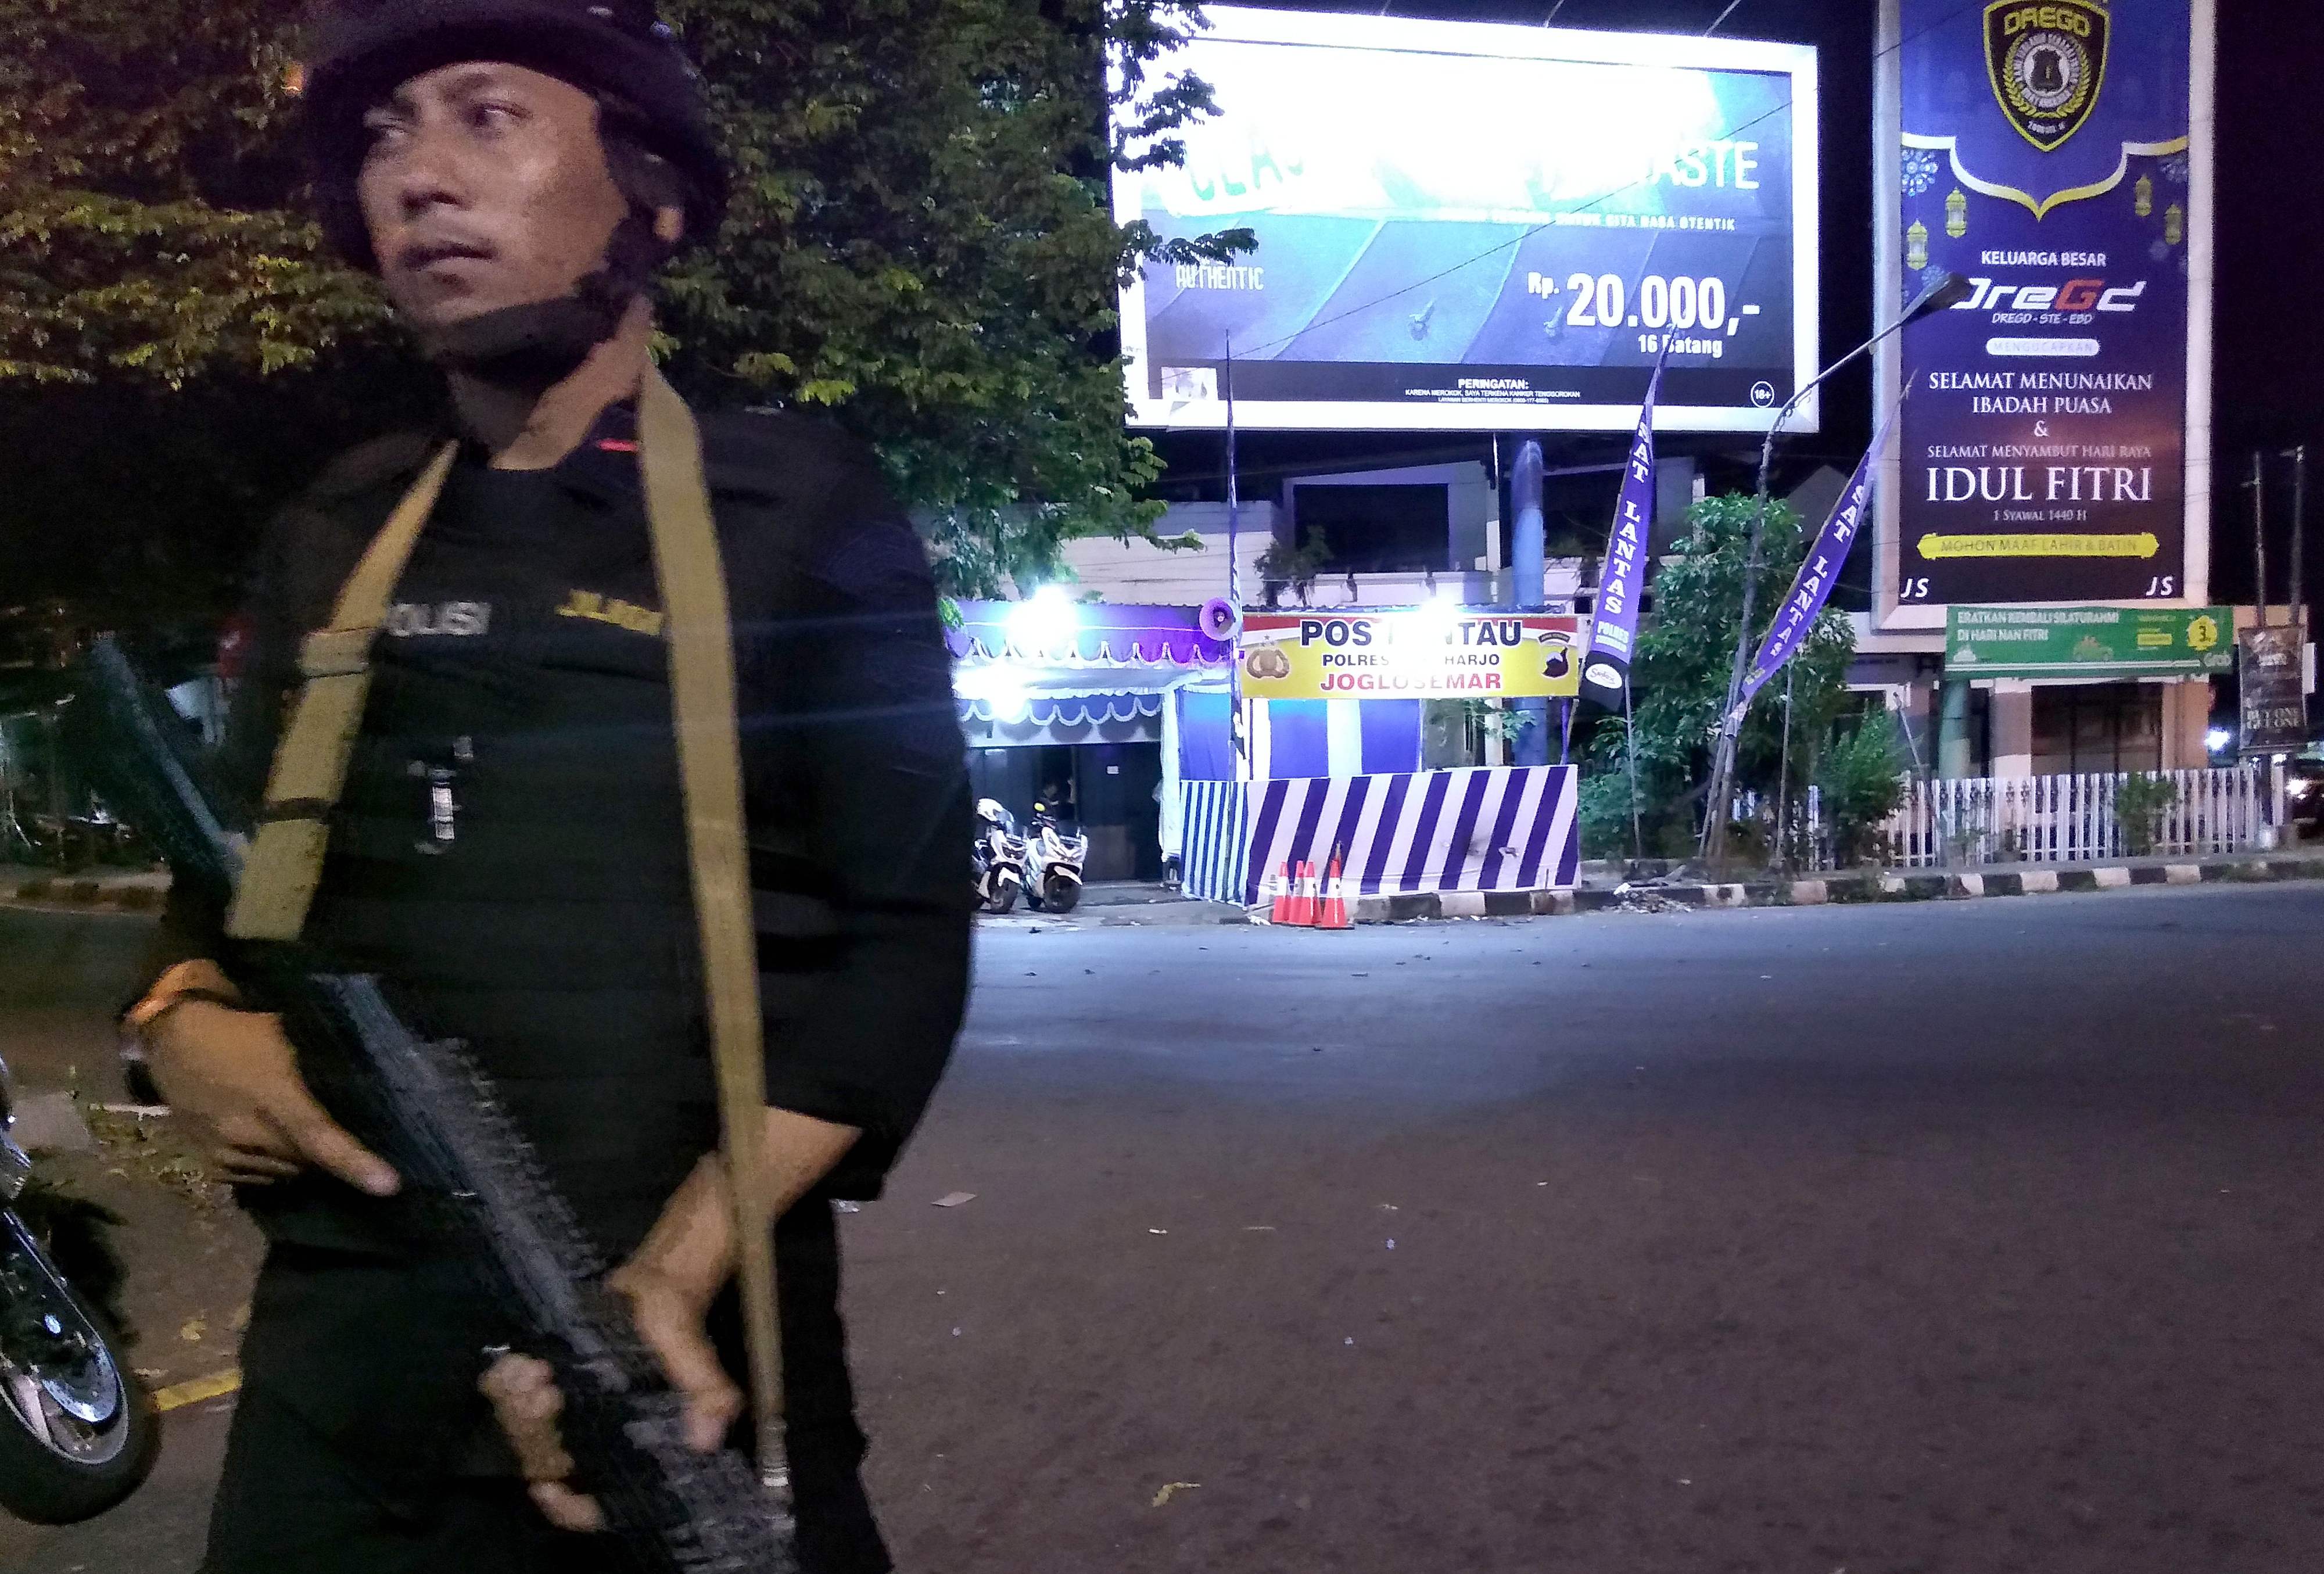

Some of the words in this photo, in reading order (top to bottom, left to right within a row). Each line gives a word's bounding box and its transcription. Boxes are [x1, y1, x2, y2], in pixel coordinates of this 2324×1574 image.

[1641, 215, 1675, 229] RASA
[1680, 216, 1735, 231] OTENTIK
[1982, 250, 2057, 267] KELUARGA
[2061, 252, 2107, 267] BESAR
[1176, 265, 1264, 291] AUTHENTIC
[1528, 272, 1559, 299] Rp.
[1638, 335, 1658, 353] 16
[1458, 378, 1529, 389] PERINGATAN:
[1929, 372, 2015, 390] SELAMAT
[2020, 373, 2152, 391] MENUNAIKAN
[1973, 397, 2047, 414] IBADAH
[2054, 397, 2112, 414] PUASA
[2033, 421, 2049, 437] &
[1632, 421, 1650, 483] SAT
[1928, 445, 1988, 458] SELAMAT
[1992, 445, 2081, 458] MENYAMBUT
[2083, 446, 2117, 458] HARI
[2120, 446, 2152, 459] RAYA
[1926, 467, 2033, 502] IDUL
[2046, 467, 2152, 502] FITRI
[1833, 485, 1864, 543] SAT
[1993, 510, 2000, 521] 1
[2050, 510, 2074, 521] 1440
[2077, 510, 2087, 521] H
[1941, 539, 1995, 551] MOHON
[2000, 539, 2038, 551] MAAF
[2042, 539, 2085, 551] LAHIR
[2086, 540, 2094, 550] &
[2099, 540, 2137, 551] BATIN
[1604, 501, 1641, 615] LANTAS
[1769, 555, 1828, 658] LANTAS
[1957, 611, 2004, 623] ERATKAN
[1301, 621, 1372, 646] POS
[1957, 628, 1968, 641] DI
[1971, 628, 1996, 641] HARI
[1999, 628, 2021, 641] NAN
[2022, 628, 2049, 641] FITRI
[1322, 654, 1389, 666] POLRES
[1321, 673, 1501, 691] JOGLOSEMAR
